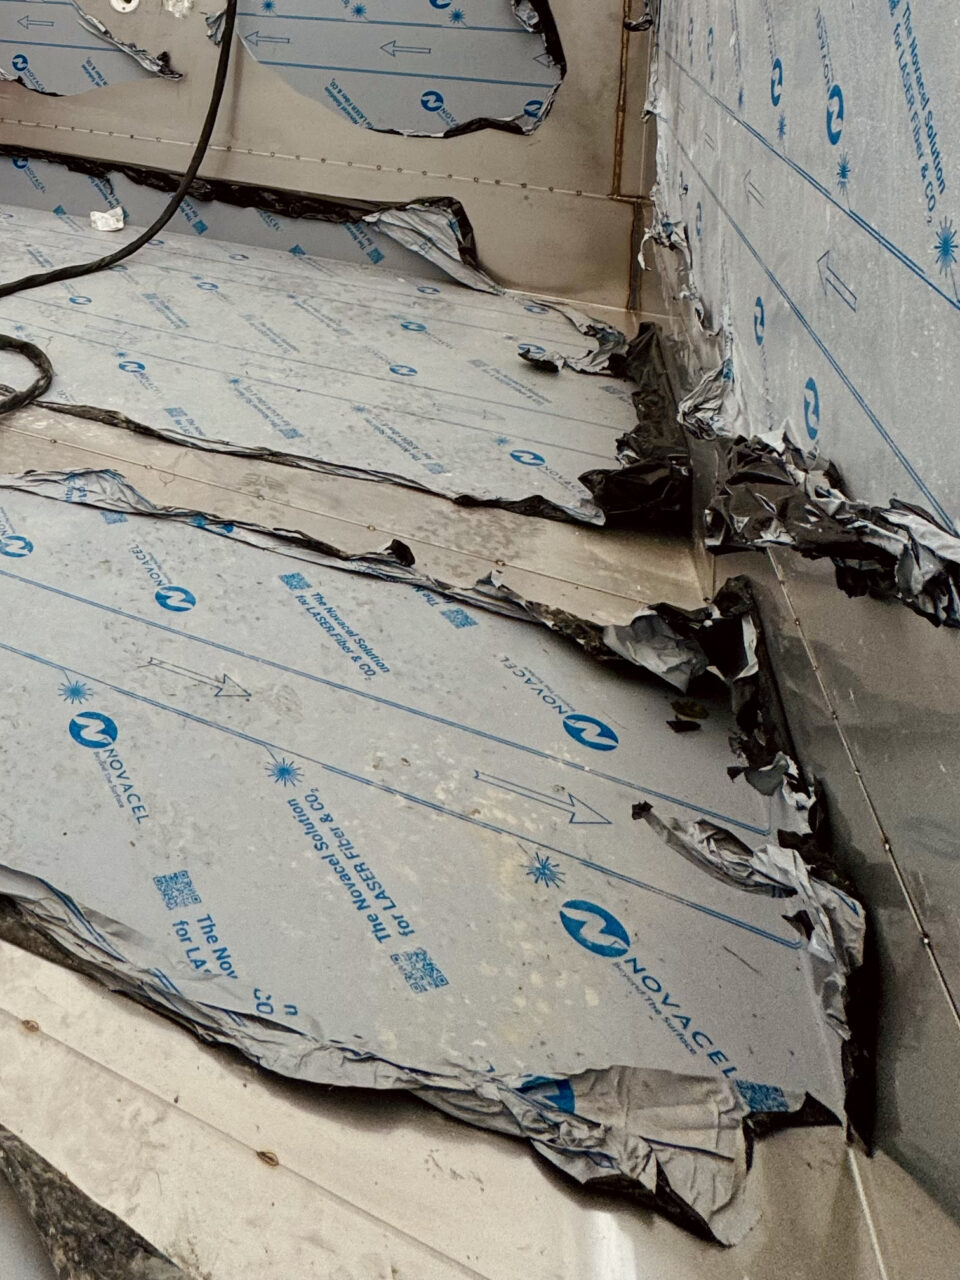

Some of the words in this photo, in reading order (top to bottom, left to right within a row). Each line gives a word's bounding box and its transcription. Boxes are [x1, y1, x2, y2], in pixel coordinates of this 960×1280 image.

[892, 22, 902, 51] for
[898, 48, 914, 112] LASER
[910, 109, 924, 160] Fiber
[902, 1, 912, 39] The
[908, 36, 930, 113] Novacel
[924, 109, 945, 195] Solution
[130, 543, 166, 586] NOVACEL
[424, 592, 440, 607] The
[304, 606, 335, 634] LASER
[328, 632, 354, 653] Fiber
[310, 591, 327, 606] The
[323, 606, 359, 637] Novacel
[353, 637, 390, 673] Solution
[500, 656, 568, 714] NOVACEL
[107, 748, 149, 824] NOVACEL
[287, 798, 329, 851] Solution
[329, 826, 360, 860] Fiber
[320, 852, 371, 911] Novacel
[353, 861, 397, 911] LASER
[172, 920, 191, 943] for
[196, 914, 218, 945] The
[366, 912, 391, 943] The
[390, 913, 415, 936] for
[614, 962, 646, 1000] Beyond
[646, 997, 662, 1015] The
[661, 1016, 697, 1056] Surface
[625, 957, 739, 1079] NOVACEL
